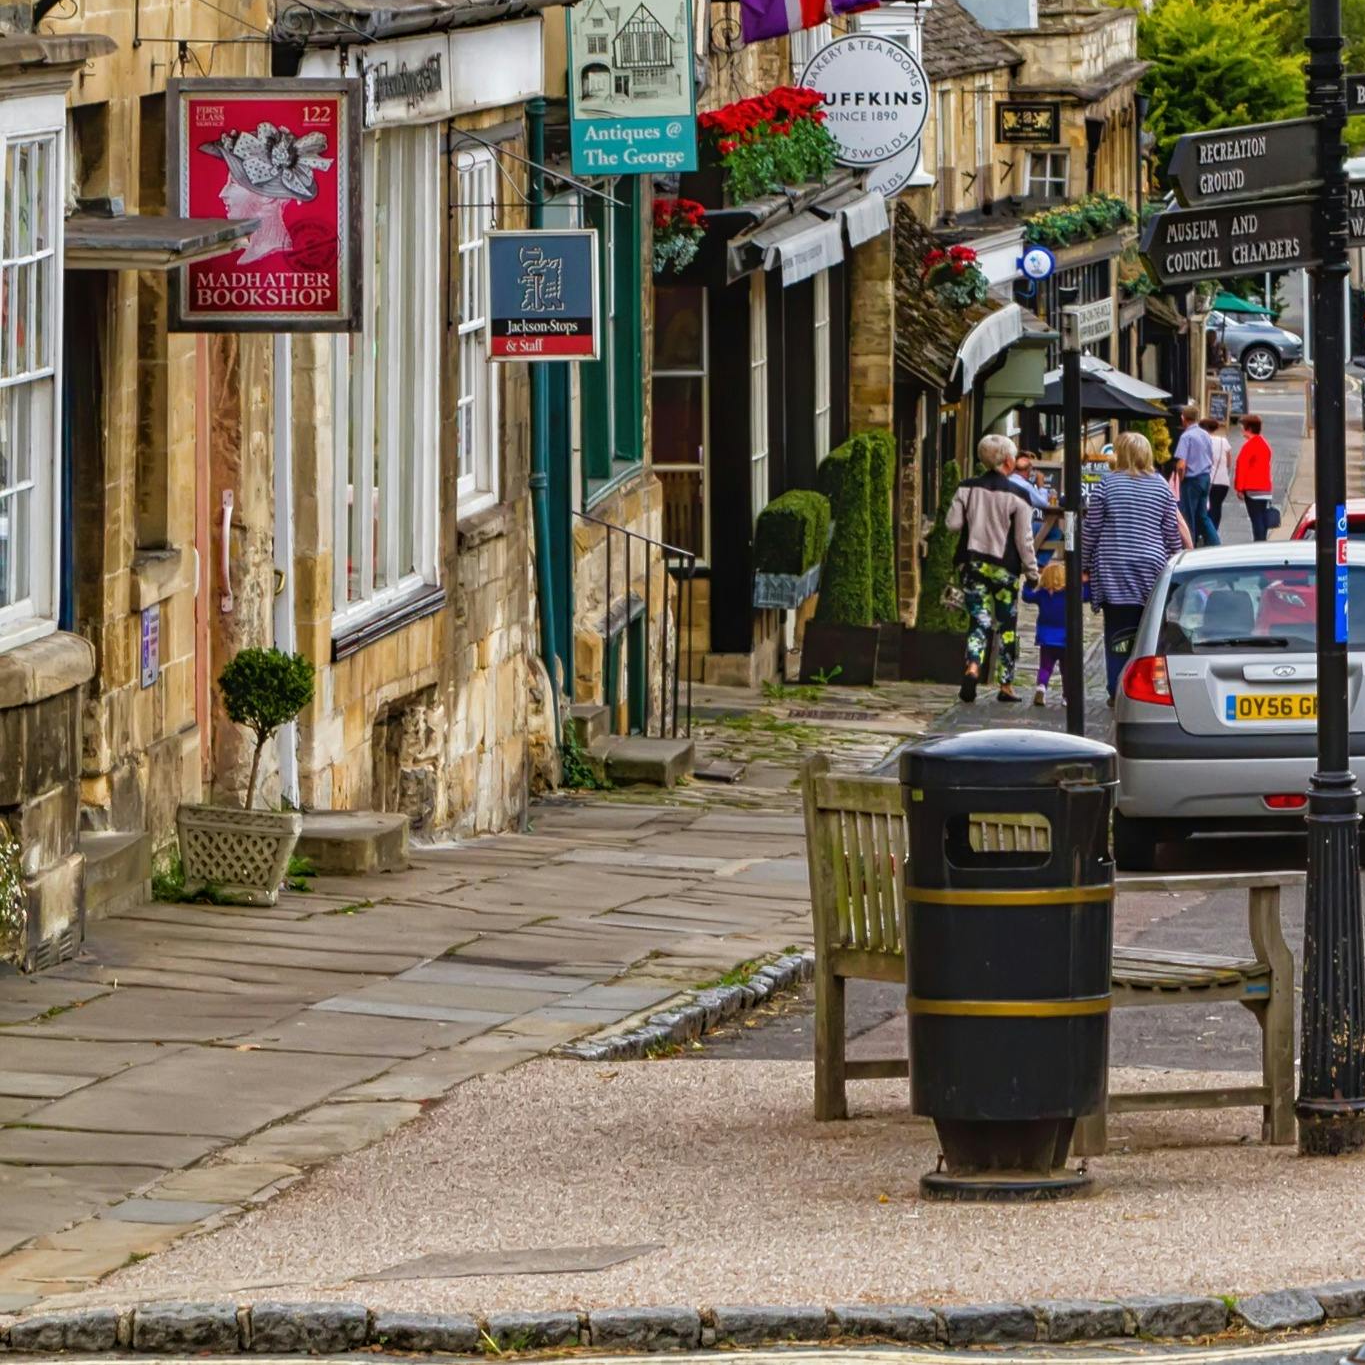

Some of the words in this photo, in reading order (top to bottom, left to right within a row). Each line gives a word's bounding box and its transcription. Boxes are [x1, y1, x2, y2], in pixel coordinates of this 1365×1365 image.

[806, 45, 843, 87] BAKERY
[848, 42, 855, 52] &
[858, 40, 883, 53] TEA
[886, 48, 921, 87] ROOMS
[823, 91, 922, 106] UFFKINS
[302, 106, 331, 122] 122
[829, 111, 867, 122] SINCE
[871, 111, 898, 121] 1890
[584, 124, 660, 144] Antiques
[666, 122, 682, 137] @
[584, 149, 618, 165] The
[623, 148, 685, 168] George
[1200, 136, 1266, 164] RECREATION
[1200, 169, 1245, 194] GROUND
[1166, 219, 1219, 244] MUSEUM
[1231, 214, 1258, 235] AND
[1166, 247, 1222, 273] COUNCIL
[1232, 238, 1300, 265] CHAMBERS
[197, 272, 330, 288] MADHATTER
[197, 289, 331, 306] BOOKSHOP
[506, 341, 517, 352] &
[519, 339, 544, 352] Staff
[1239, 697, 1293, 716] OY56
